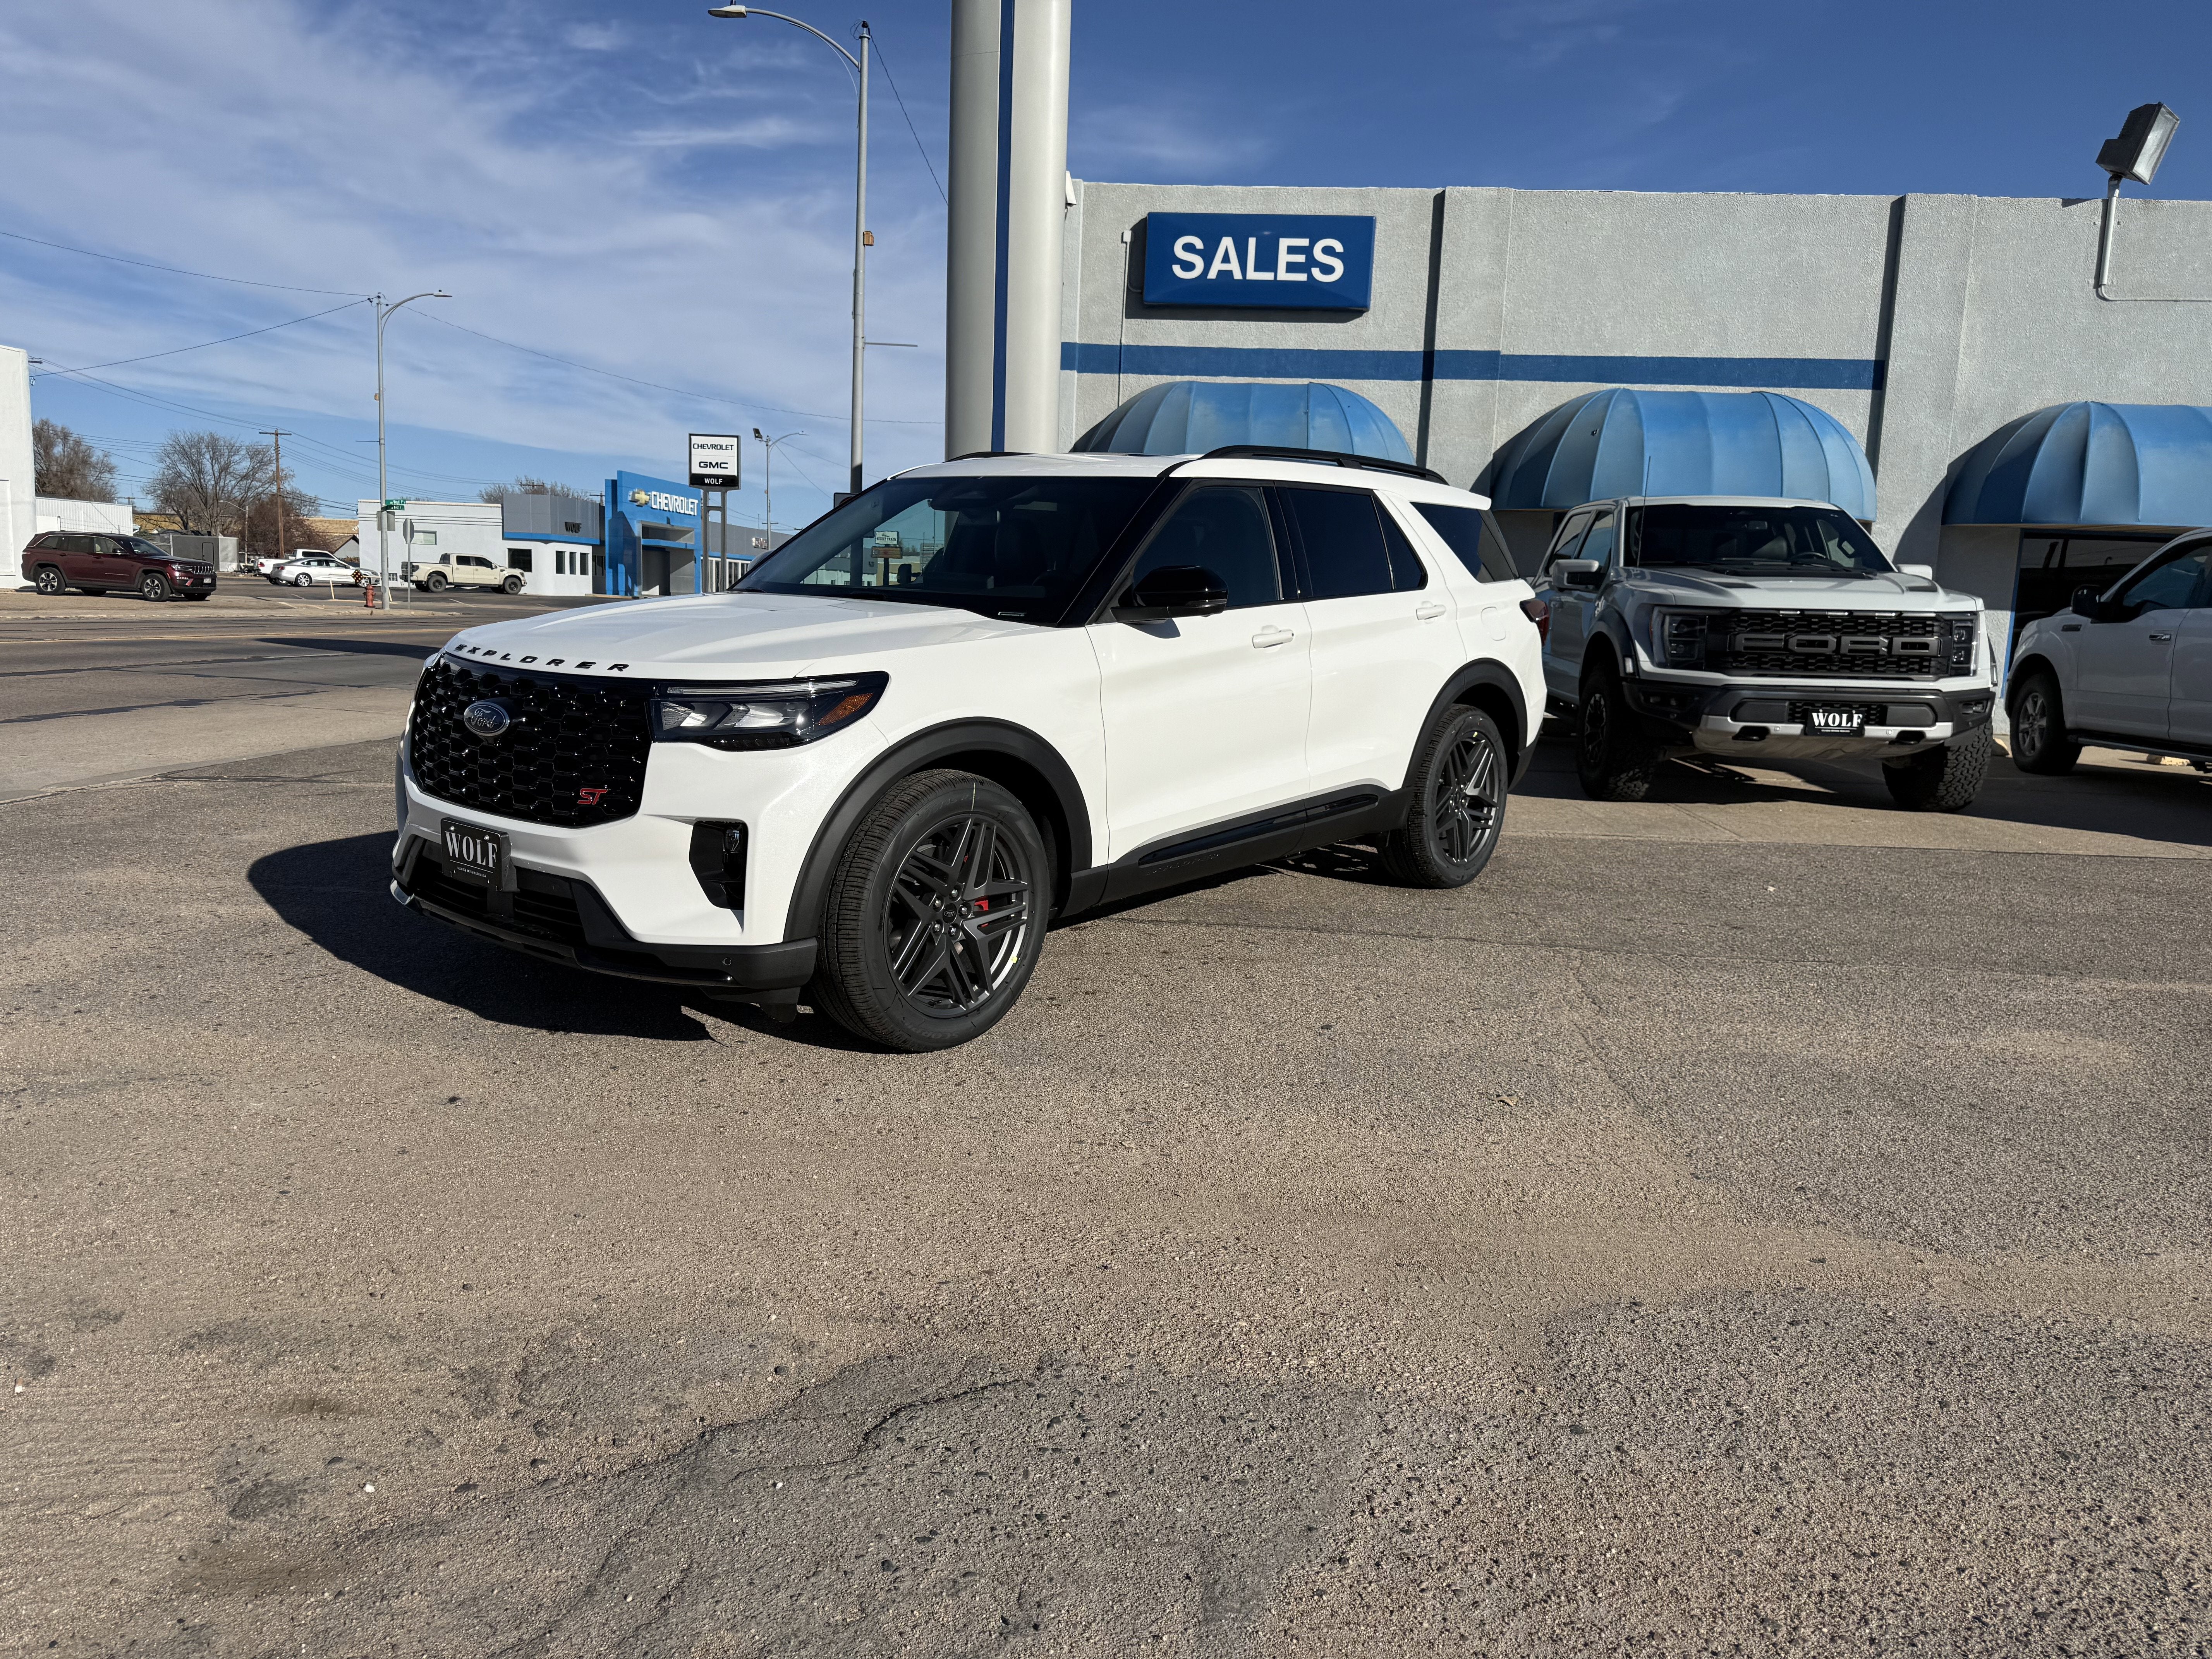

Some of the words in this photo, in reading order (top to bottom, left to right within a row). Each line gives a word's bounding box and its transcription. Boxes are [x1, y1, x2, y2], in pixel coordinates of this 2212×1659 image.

[1171, 235, 1344, 283] SALES
[651, 491, 698, 515] CHEVROLET
[564, 521, 582, 533] WOLF
[1734, 633, 1939, 656] FORD
[453, 644, 629, 672] EXPLORER
[471, 708, 496, 728] Ford
[1812, 713, 1863, 727] WOLF
[577, 788, 608, 805] ST
[445, 831, 498, 868] WOLF
